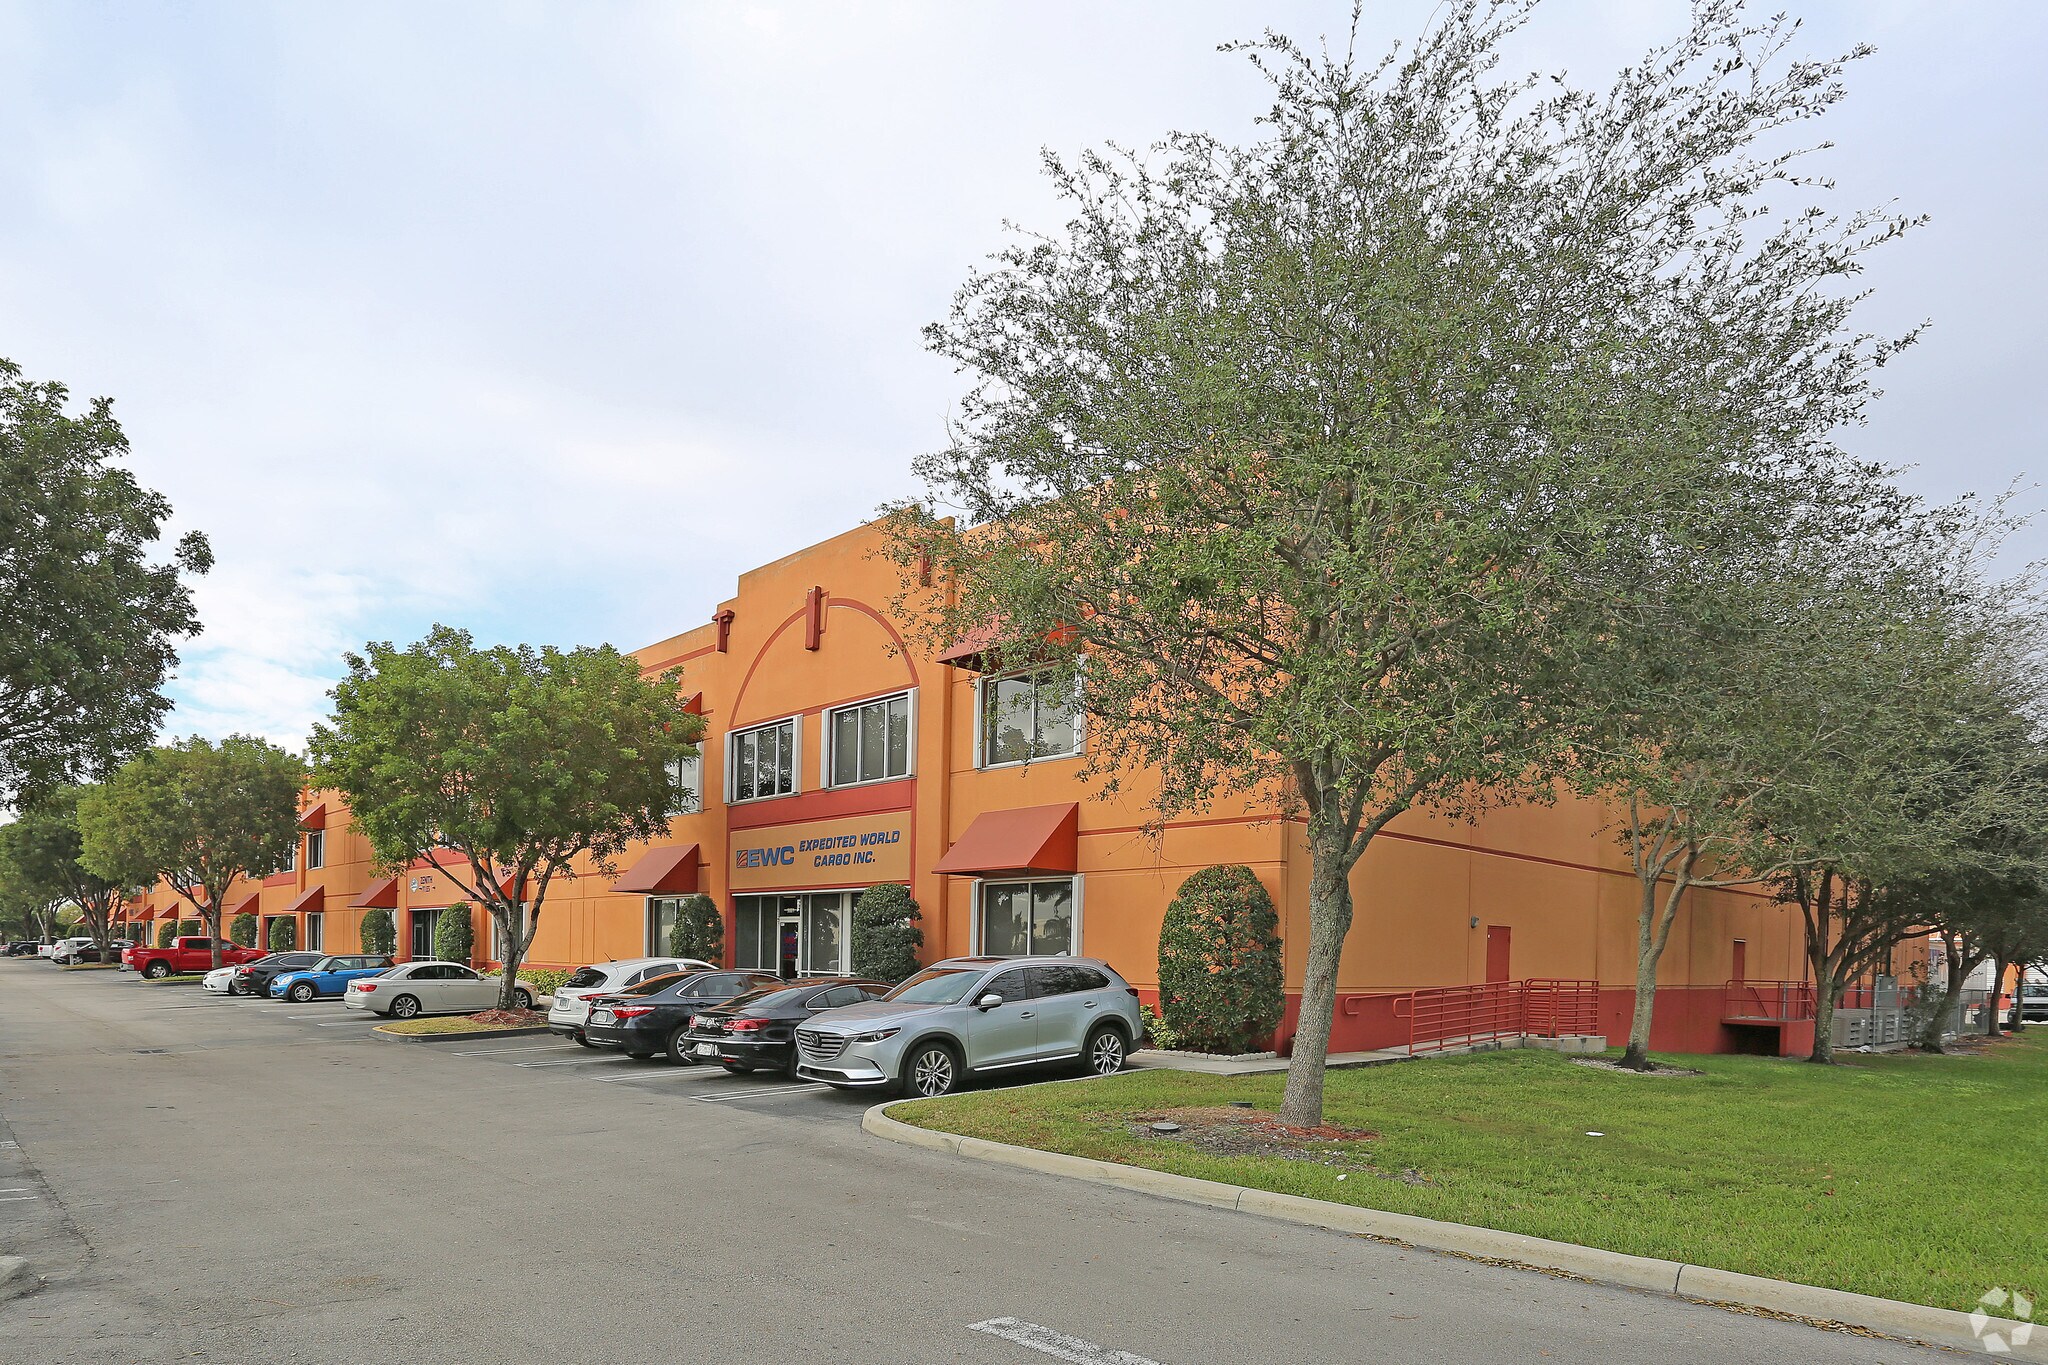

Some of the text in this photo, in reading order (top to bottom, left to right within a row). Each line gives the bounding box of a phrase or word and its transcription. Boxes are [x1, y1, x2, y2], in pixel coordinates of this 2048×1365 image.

[799, 830, 900, 852] EXPEDITED WORLD
[748, 846, 795, 867] EWC
[814, 851, 875, 867] CARGO INC.
